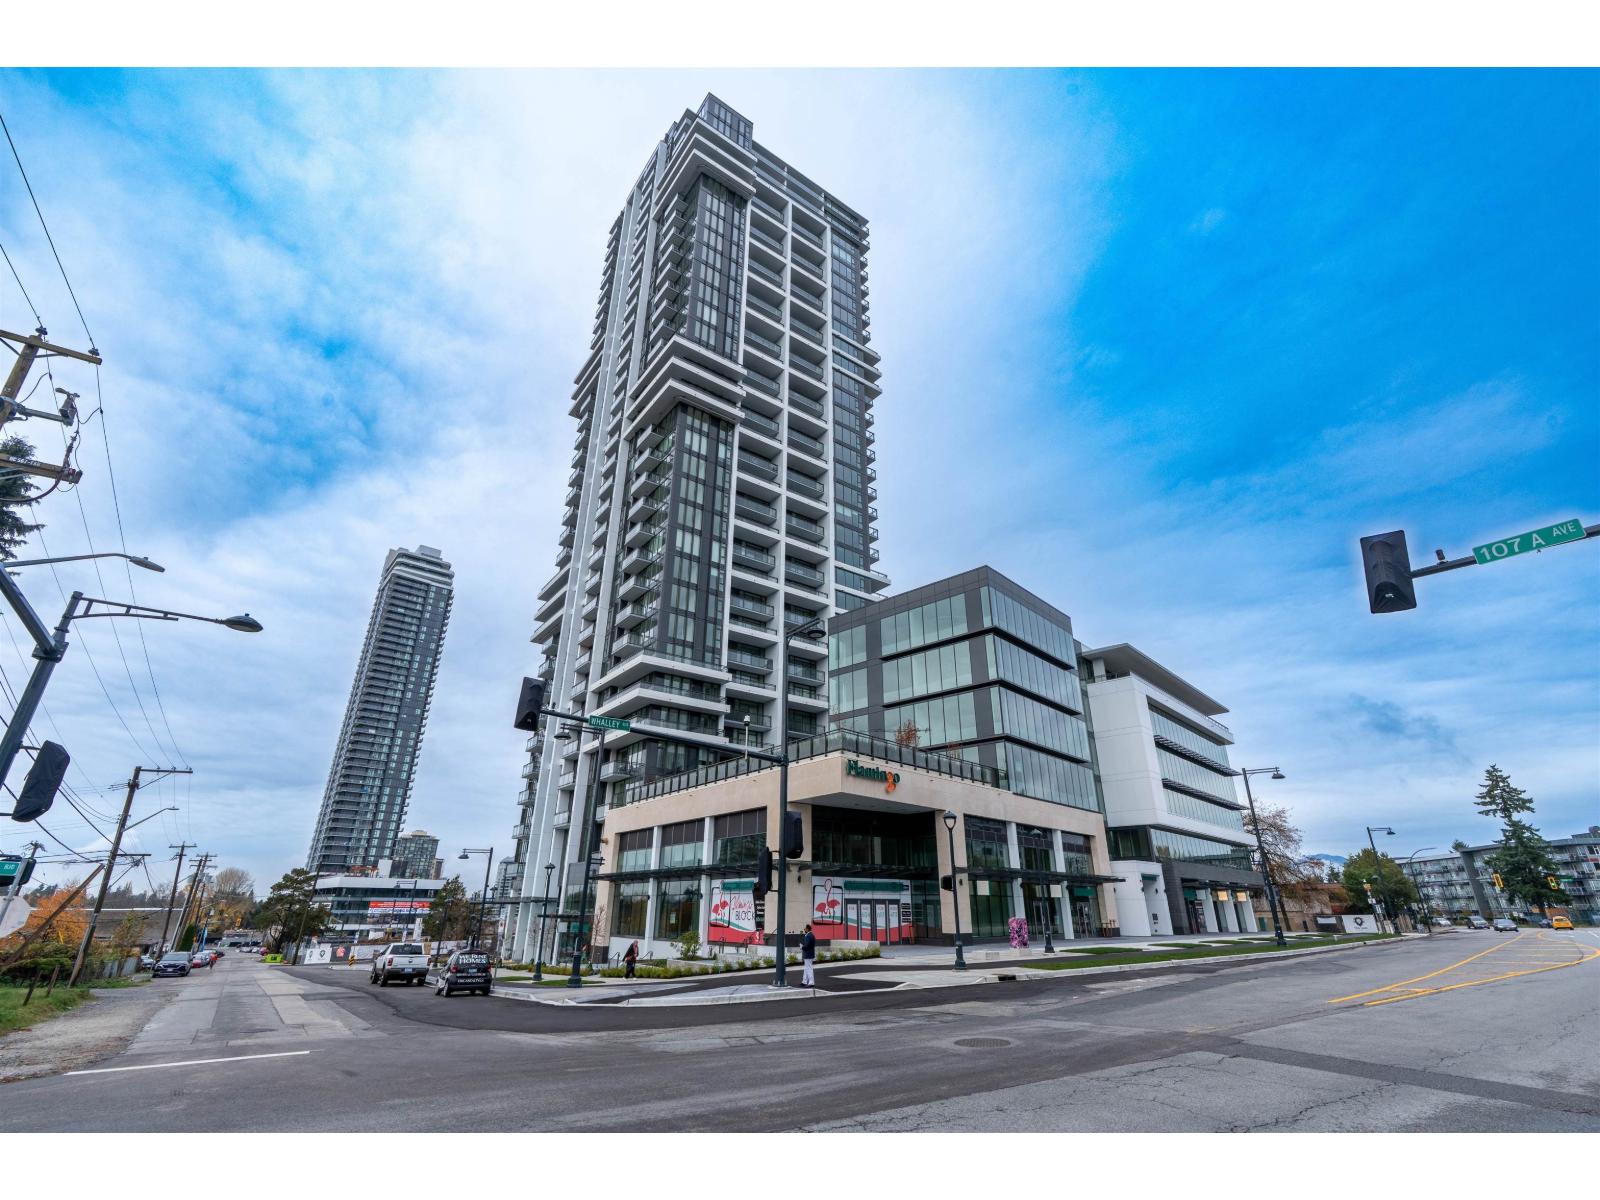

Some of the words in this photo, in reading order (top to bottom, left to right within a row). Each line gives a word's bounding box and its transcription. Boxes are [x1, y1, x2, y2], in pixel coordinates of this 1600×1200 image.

[1480, 538, 1521, 560] 107
[1531, 533, 1546, 548] A
[1552, 522, 1577, 537] AVE
[591, 717, 621, 729] WHALLEY
